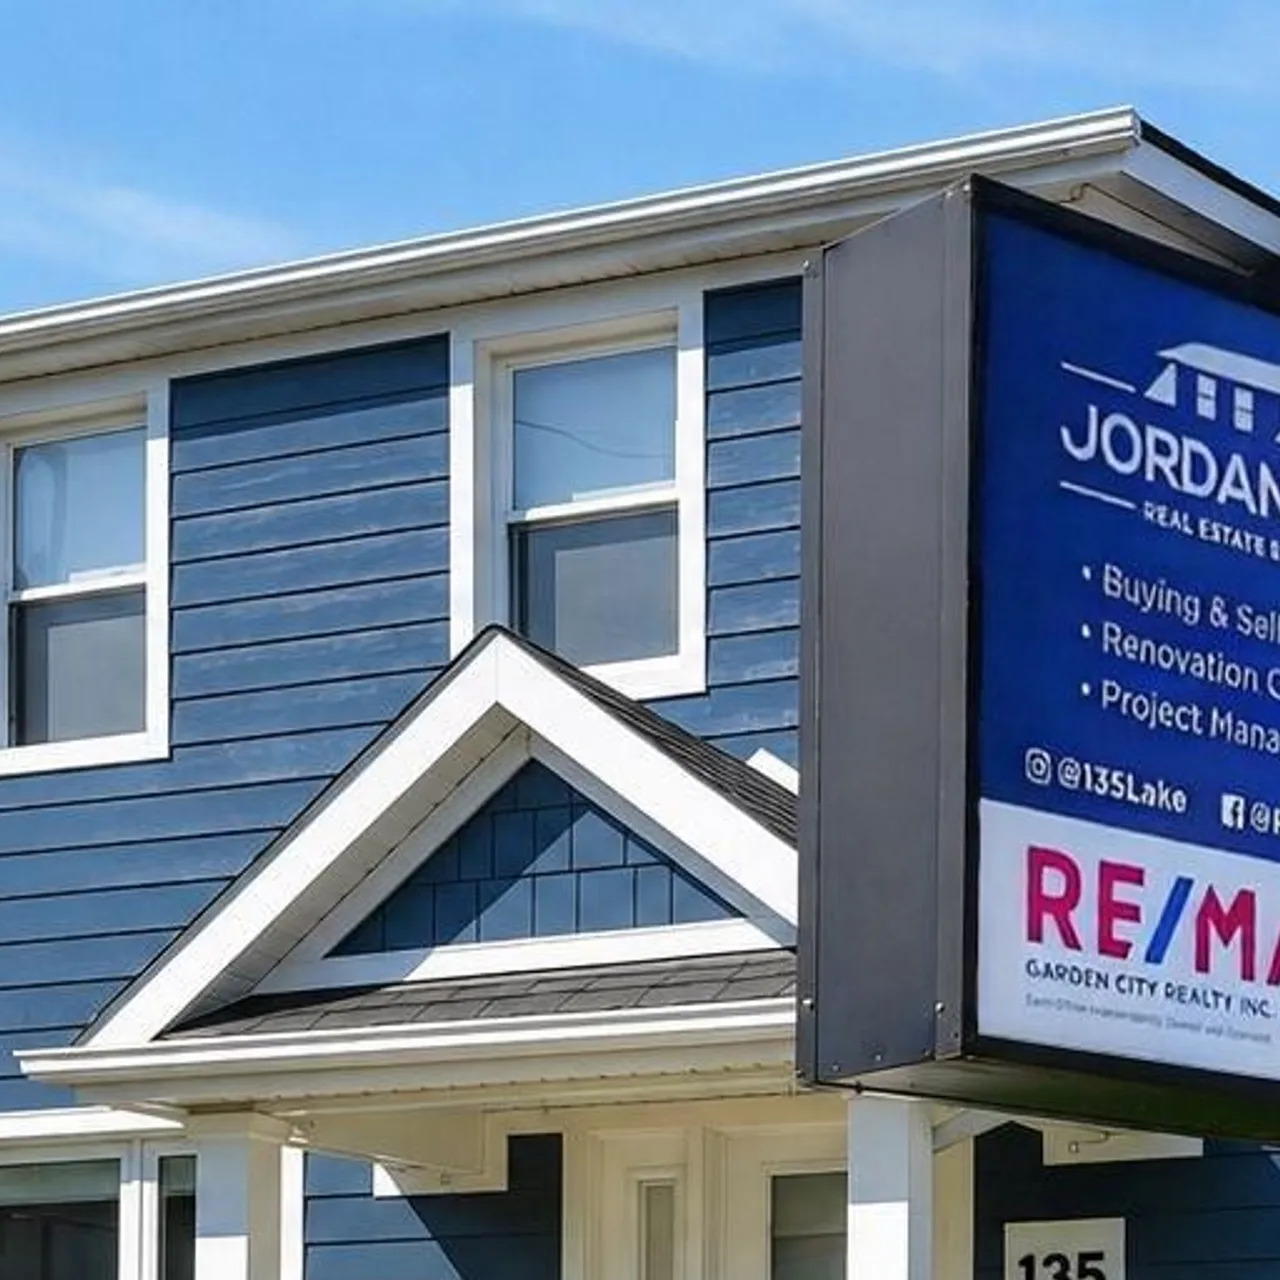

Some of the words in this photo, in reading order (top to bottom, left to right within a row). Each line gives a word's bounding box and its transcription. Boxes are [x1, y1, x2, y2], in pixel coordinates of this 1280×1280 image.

[1142, 500, 1194, 536] REAL
[1199, 517, 1265, 557] ESTATE
[1102, 563, 1201, 627] Buying
[1209, 596, 1229, 628] &
[1102, 620, 1259, 694] Renovation
[1101, 678, 1204, 735] Project
[1058, 756, 1187, 814] @135Lake
[1025, 958, 1109, 991] GARDEN
[1115, 973, 1159, 998] CITY
[1164, 981, 1232, 1012] REALTY
